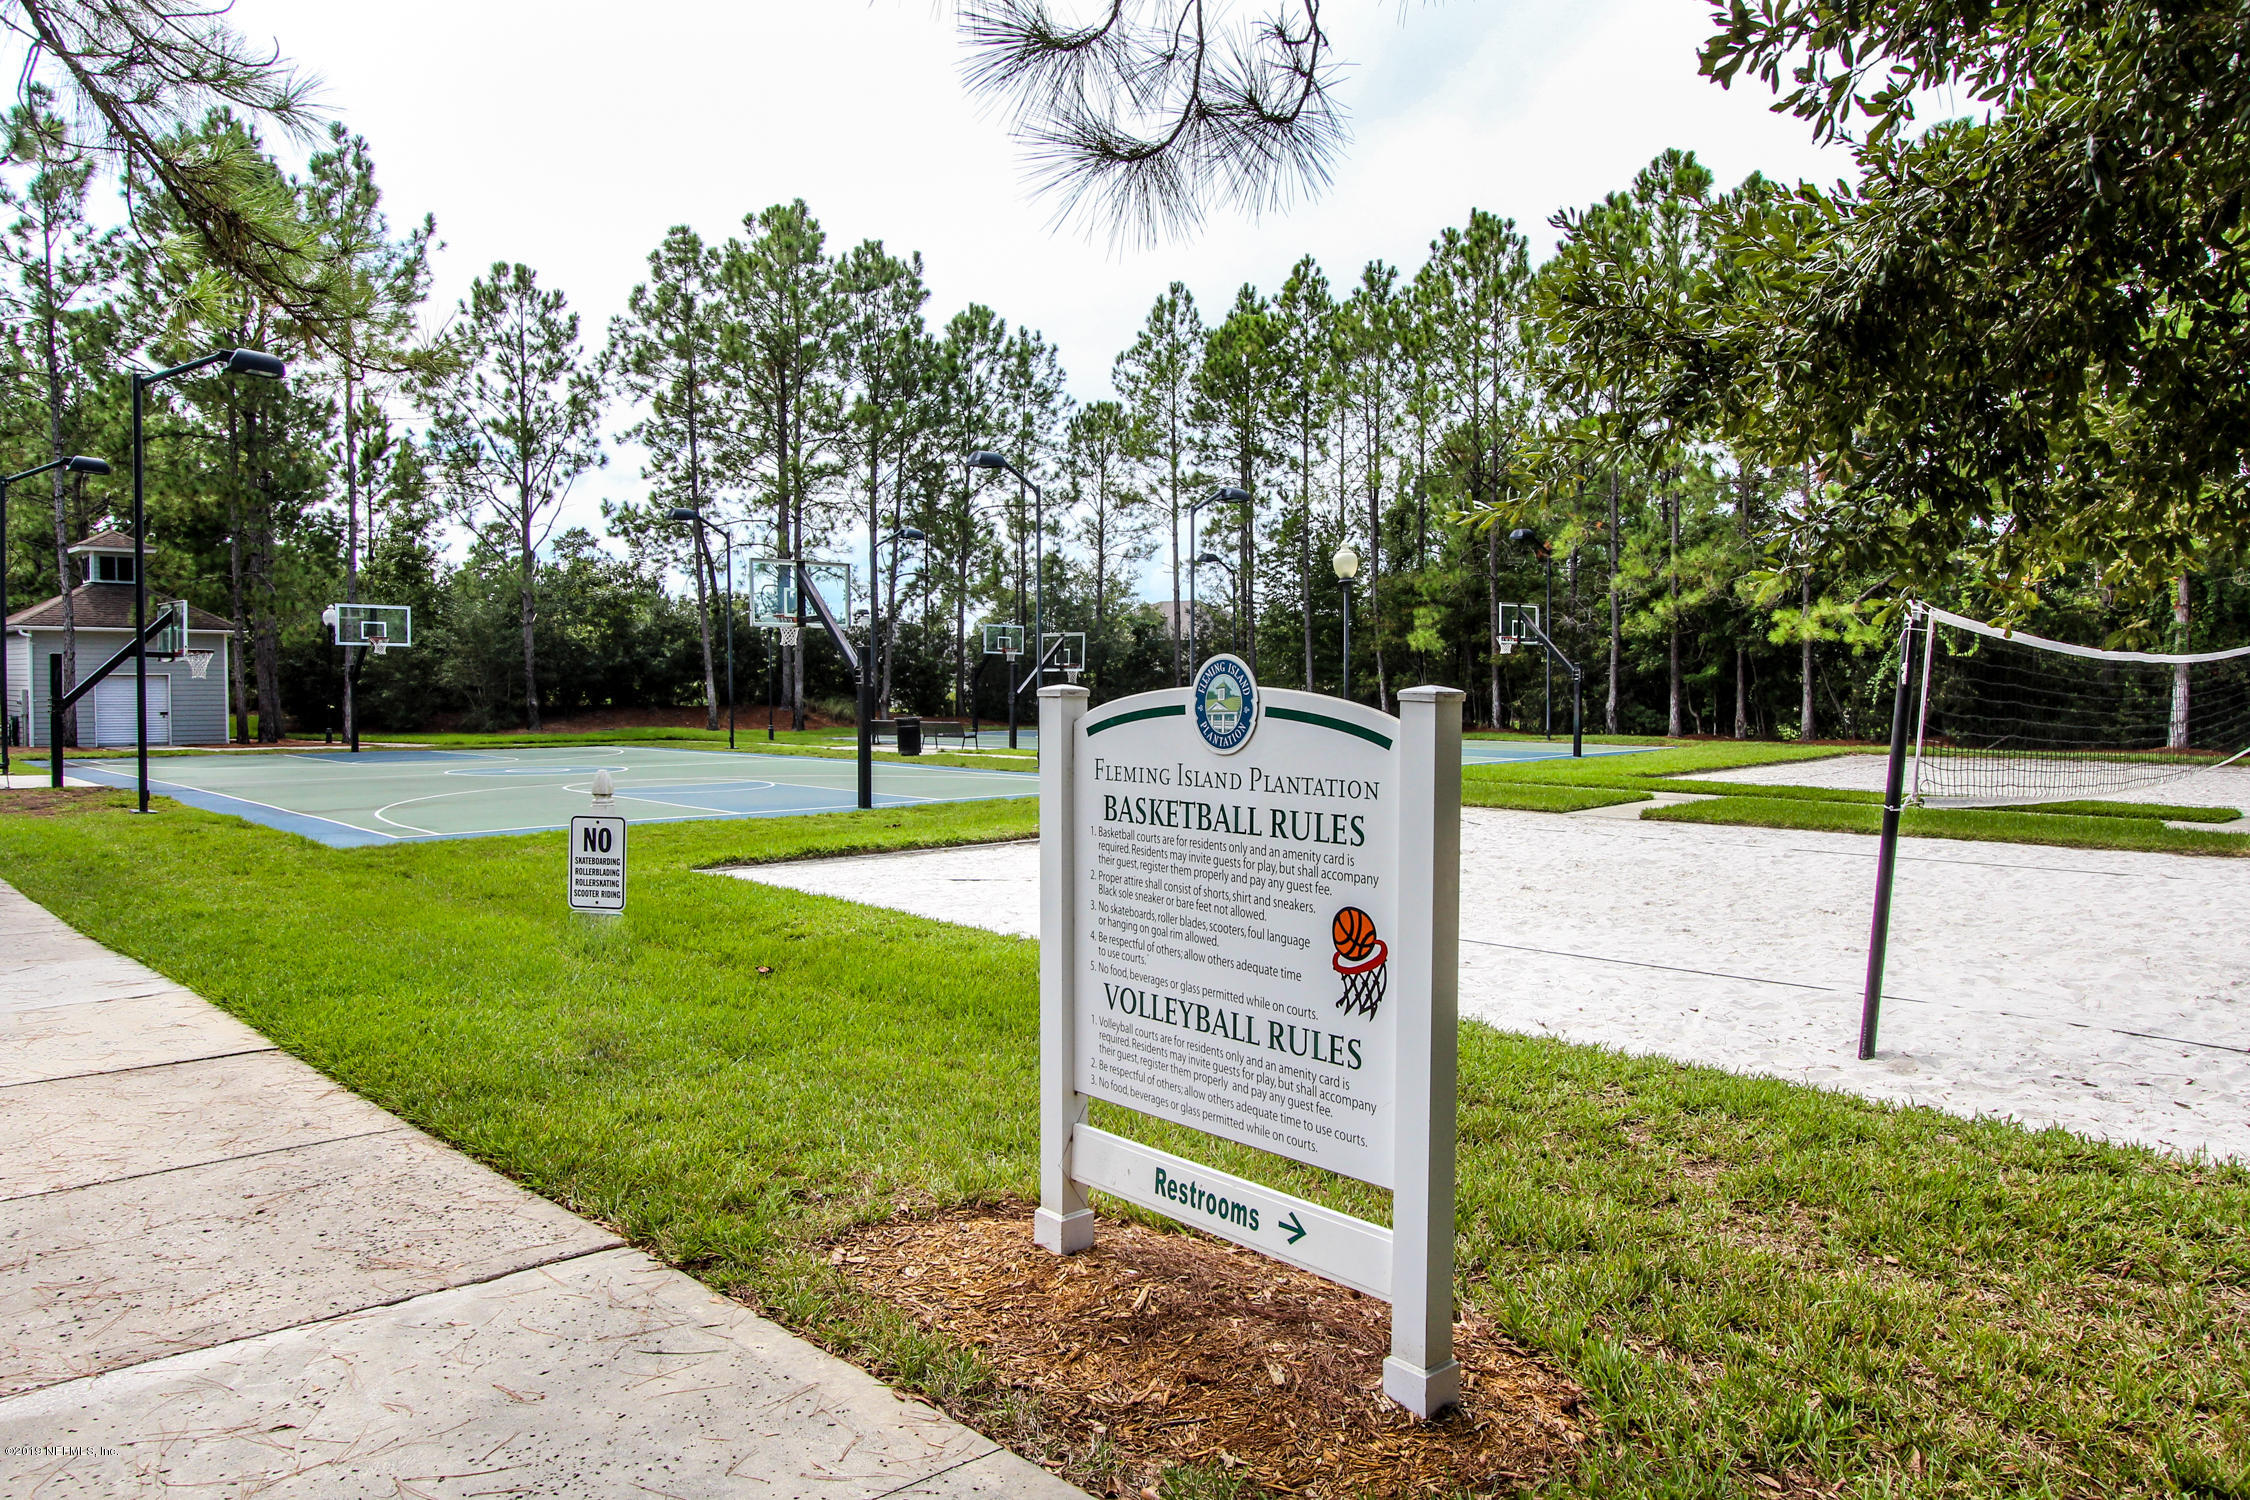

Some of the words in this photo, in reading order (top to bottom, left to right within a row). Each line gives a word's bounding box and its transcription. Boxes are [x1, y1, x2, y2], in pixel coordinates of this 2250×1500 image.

[1198, 661, 1226, 694] FLEMING
[1228, 662, 1250, 696] ISLAND
[1200, 721, 1246, 747] PLANTATION
[584, 828, 612, 852] NO
[1103, 794, 1262, 836] BASKETBALL
[1269, 808, 1365, 847] RULES
[575, 857, 620, 866] SKATEBOARDING
[1090, 825, 1097, 836] 1.
[1098, 826, 1135, 840] Basketball
[1136, 833, 1161, 844] courts
[1161, 836, 1175, 846] are
[1176, 834, 1188, 847] for
[1189, 837, 1227, 852] residents
[1228, 841, 1248, 857] only
[1249, 844, 1267, 856] and
[1268, 847, 1280, 858] an
[1282, 849, 1321, 865] amenity
[1323, 852, 1344, 866] card
[1347, 853, 1355, 867] is
[1131, 843, 1168, 859] Residents
[1169, 851, 1187, 864] may
[1188, 850, 1211, 865] invite
[1212, 856, 1241, 869] guests
[1242, 856, 1256, 870] for
[1279, 861, 1295, 876] but
[1297, 863, 1319, 878] shall
[1320, 869, 1379, 888] accompany
[575, 868, 620, 876] ROLLERBLADING
[576, 878, 619, 888] ROLLERSKATING
[1090, 869, 1096, 880] 2.
[1098, 870, 1122, 885] Proper
[1123, 875, 1143, 888] attire
[1144, 877, 1162, 890] shall
[1163, 882, 1192, 895] consist
[1192, 884, 1202, 896] of
[1232, 890, 1252, 904] shirt
[1253, 894, 1271, 907] and
[1098, 853, 1115, 865] their
[1139, 861, 1169, 874] register
[1170, 862, 1192, 876] them
[1193, 868, 1229, 885] properly
[1230, 872, 1248, 884] and
[1249, 876, 1266, 890] pay
[1267, 878, 1284, 892] any
[1286, 881, 1313, 894] guest
[574, 889, 599, 898] SCOOTER
[601, 890, 620, 898] RIDING
[1098, 883, 1117, 897] Black
[1118, 887, 1134, 900] sole
[1134, 891, 1165, 905] sneaker
[1165, 897, 1175, 906] or
[1176, 895, 1194, 910] bare
[1195, 898, 1212, 913] feet
[1213, 904, 1229, 916] not
[1090, 899, 1096, 911] 3.
[1098, 900, 1109, 913] No
[1157, 911, 1178, 925] roller
[1247, 925, 1265, 940] foul
[1267, 929, 1310, 949] language
[1098, 916, 1106, 926] or
[1107, 915, 1138, 935] hanging
[1139, 924, 1150, 934] on
[1150, 926, 1168, 938] goal
[1169, 927, 1183, 940] rim
[1090, 930, 1096, 941] 4.
[1098, 931, 1108, 943] Be
[1108, 936, 1145, 951] respectful
[1146, 941, 1155, 952] of
[1183, 948, 1206, 963] allow
[1207, 953, 1234, 969] others
[1236, 959, 1278, 977] adequate
[1280, 967, 1302, 982] time
[1098, 946, 1106, 956] to
[1107, 949, 1120, 960] use
[1090, 960, 1097, 971] 5.
[1098, 961, 1109, 974] No
[1129, 968, 1169, 988] beverages
[1169, 980, 1179, 990] or
[1179, 980, 1200, 995] glass
[1202, 987, 1244, 1004] permitted
[1246, 995, 1271, 1010] while
[1272, 1002, 1284, 1013] on
[1103, 982, 1260, 1046] VOLLEYBALL
[1267, 1020, 1362, 1070] RULES
[1091, 1014, 1097, 1025] 1.
[1098, 1015, 1133, 1035] Volleyball
[1134, 1027, 1159, 1042] courts
[1159, 1034, 1173, 1045] are
[1173, 1034, 1185, 1048] for
[1186, 1041, 1224, 1059] residents
[1225, 1050, 1245, 1065] only
[1245, 1056, 1263, 1068] and
[1265, 1061, 1277, 1072] an
[1278, 1064, 1317, 1084] amenity
[1318, 1074, 1340, 1088] card
[1342, 1077, 1350, 1091] is
[1090, 1057, 1097, 1069] 2.
[1098, 1059, 1108, 1072] Be
[1109, 1065, 1145, 1083] respectful
[1146, 1074, 1156, 1086] of
[1183, 1085, 1206, 1101] allow
[1207, 1092, 1234, 1109] others
[1236, 1101, 1278, 1122] adequate
[1280, 1112, 1301, 1128] time
[1303, 1119, 1313, 1132] to
[1315, 1124, 1332, 1137] use
[1099, 1043, 1116, 1057] their
[1140, 1056, 1169, 1072] register
[1170, 1062, 1192, 1078] them
[1193, 1071, 1229, 1091] properly
[1232, 1082, 1249, 1094] and
[1250, 1087, 1267, 1102] pay
[1268, 1092, 1286, 1107] any
[1287, 1097, 1314, 1113] guest
[1131, 1037, 1168, 1058] Residents
[1169, 1050, 1187, 1065] may
[1188, 1052, 1211, 1070] invite
[1212, 1062, 1241, 1078] guests
[1242, 1066, 1254, 1081] for
[1277, 1075, 1294, 1092] but
[1295, 1081, 1317, 1098] shall
[1319, 1089, 1377, 1115] accompany
[1090, 1073, 1097, 1086] 3.
[1098, 1076, 1109, 1089] No
[1129, 1085, 1169, 1108] beverages
[1170, 1100, 1179, 1110] or
[1180, 1102, 1201, 1118] glass
[1202, 1110, 1244, 1130] permitted
[1246, 1122, 1270, 1139] while
[1272, 1131, 1284, 1143] on
[1155, 1167, 1259, 1231] Restrooms
